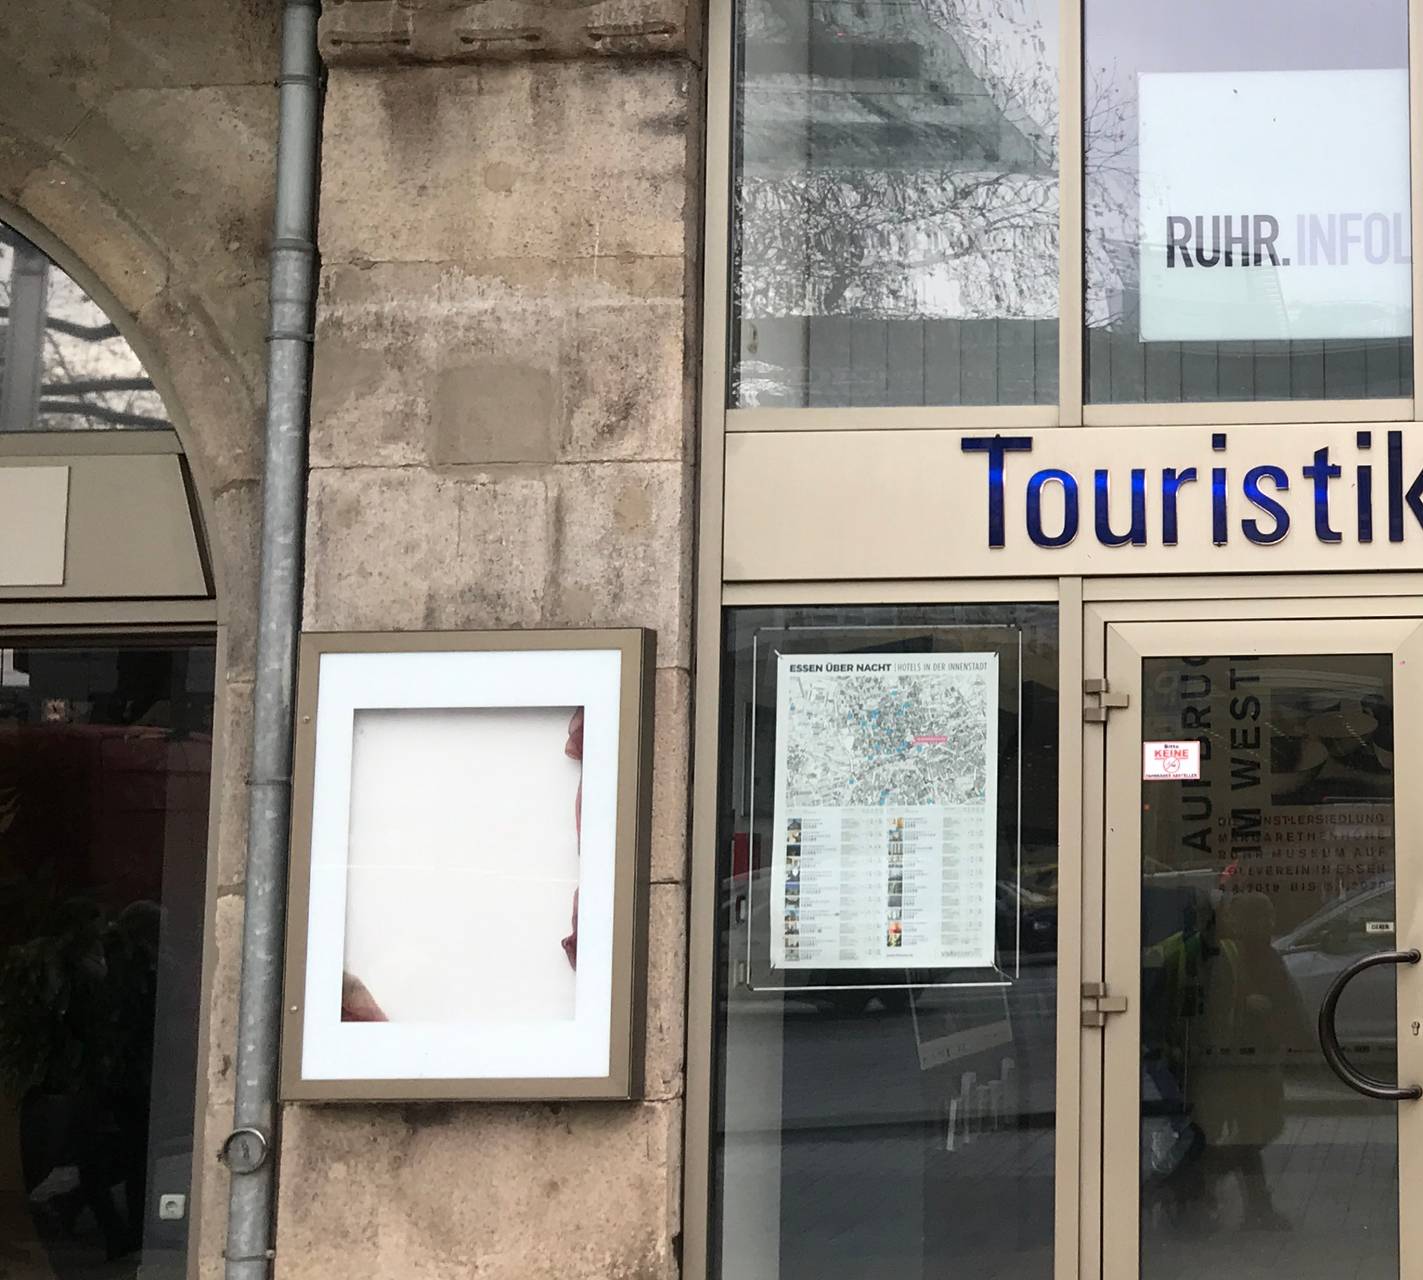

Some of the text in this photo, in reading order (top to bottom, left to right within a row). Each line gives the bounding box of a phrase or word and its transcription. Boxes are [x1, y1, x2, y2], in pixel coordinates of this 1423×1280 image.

[789, 663, 823, 673] ESSEN
[825, 661, 854, 673] ÜBER
[856, 663, 892, 672] NACHT
[897, 662, 921, 672] HOTELS
[948, 661, 988, 671] INNENSTADT
[1229, 656, 1261, 791] WEST
[1154, 749, 1189, 758] KEINE
